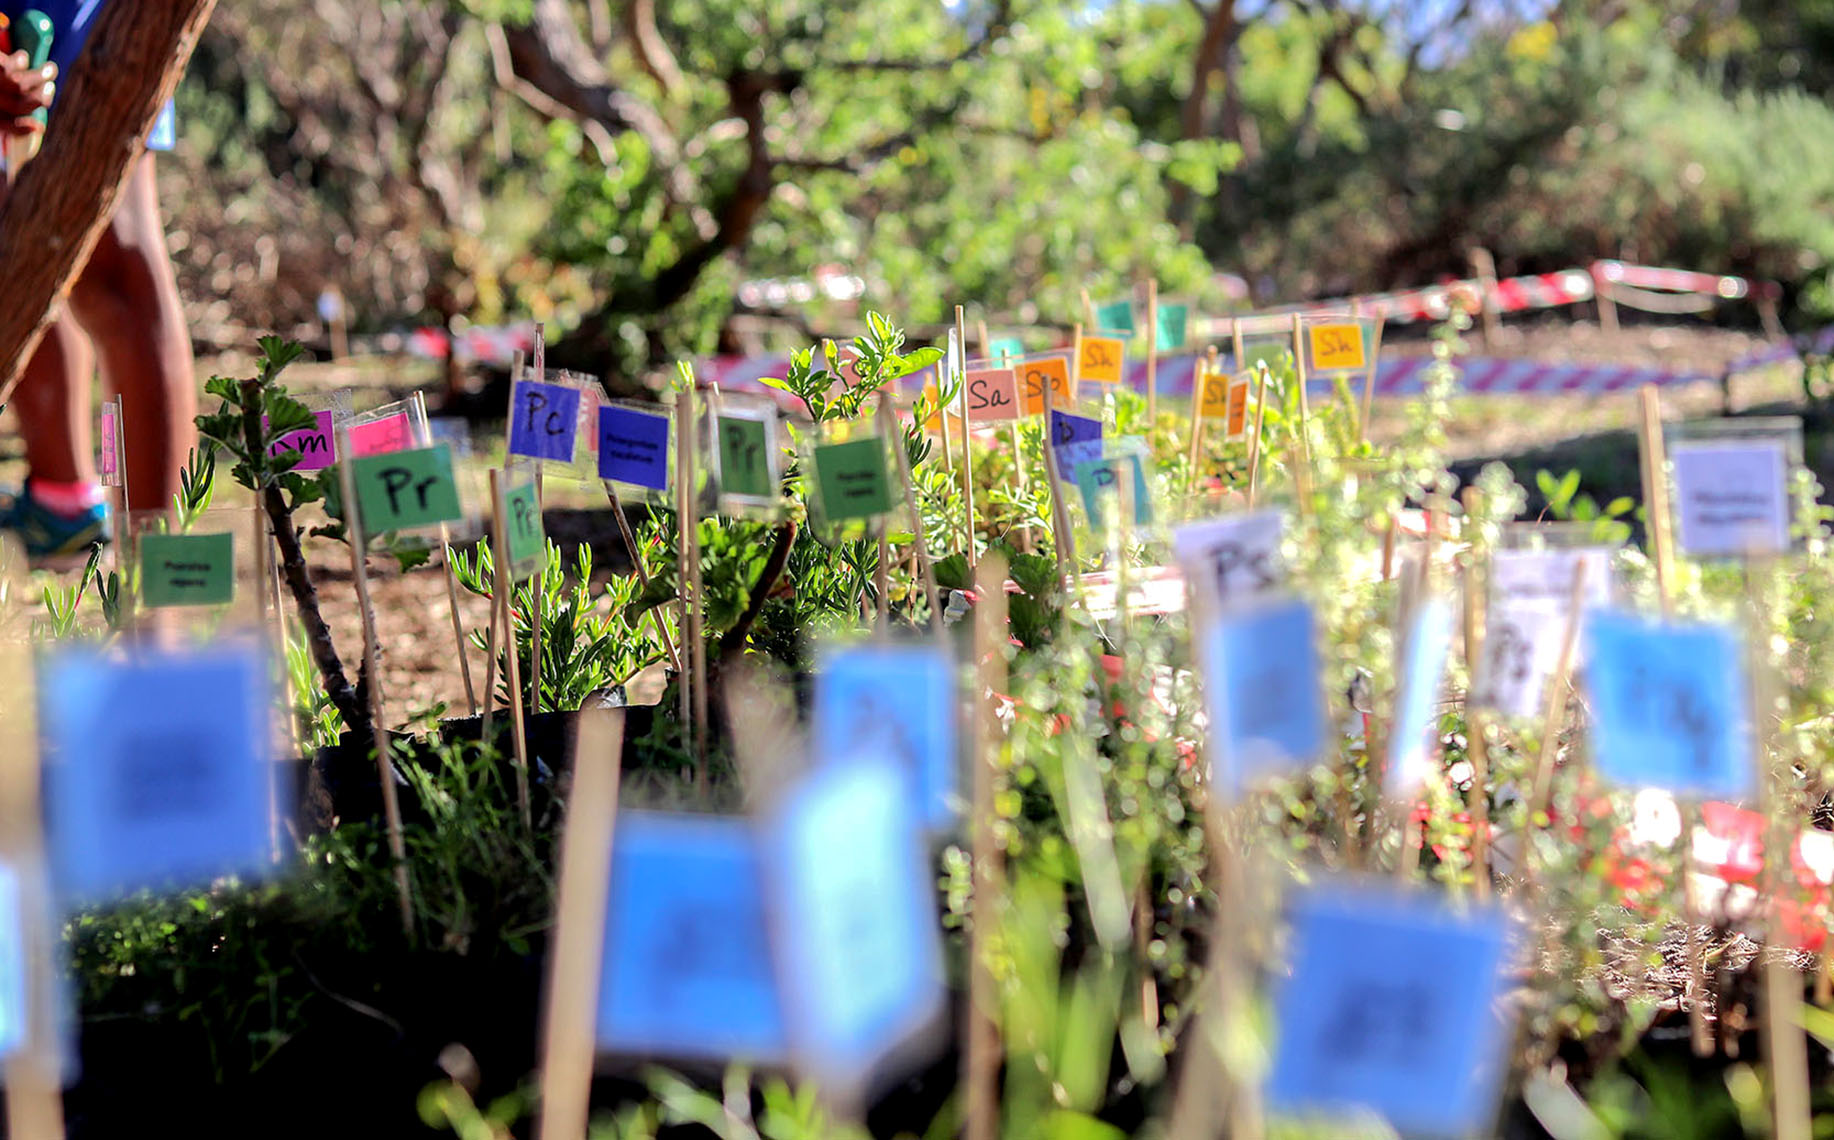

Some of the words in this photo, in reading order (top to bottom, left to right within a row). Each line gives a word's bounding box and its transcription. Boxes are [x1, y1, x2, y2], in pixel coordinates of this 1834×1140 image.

[526, 391, 565, 436] Pc
[970, 379, 1010, 408] Sa
[725, 426, 759, 472] Pr
[376, 466, 439, 517] Pr
